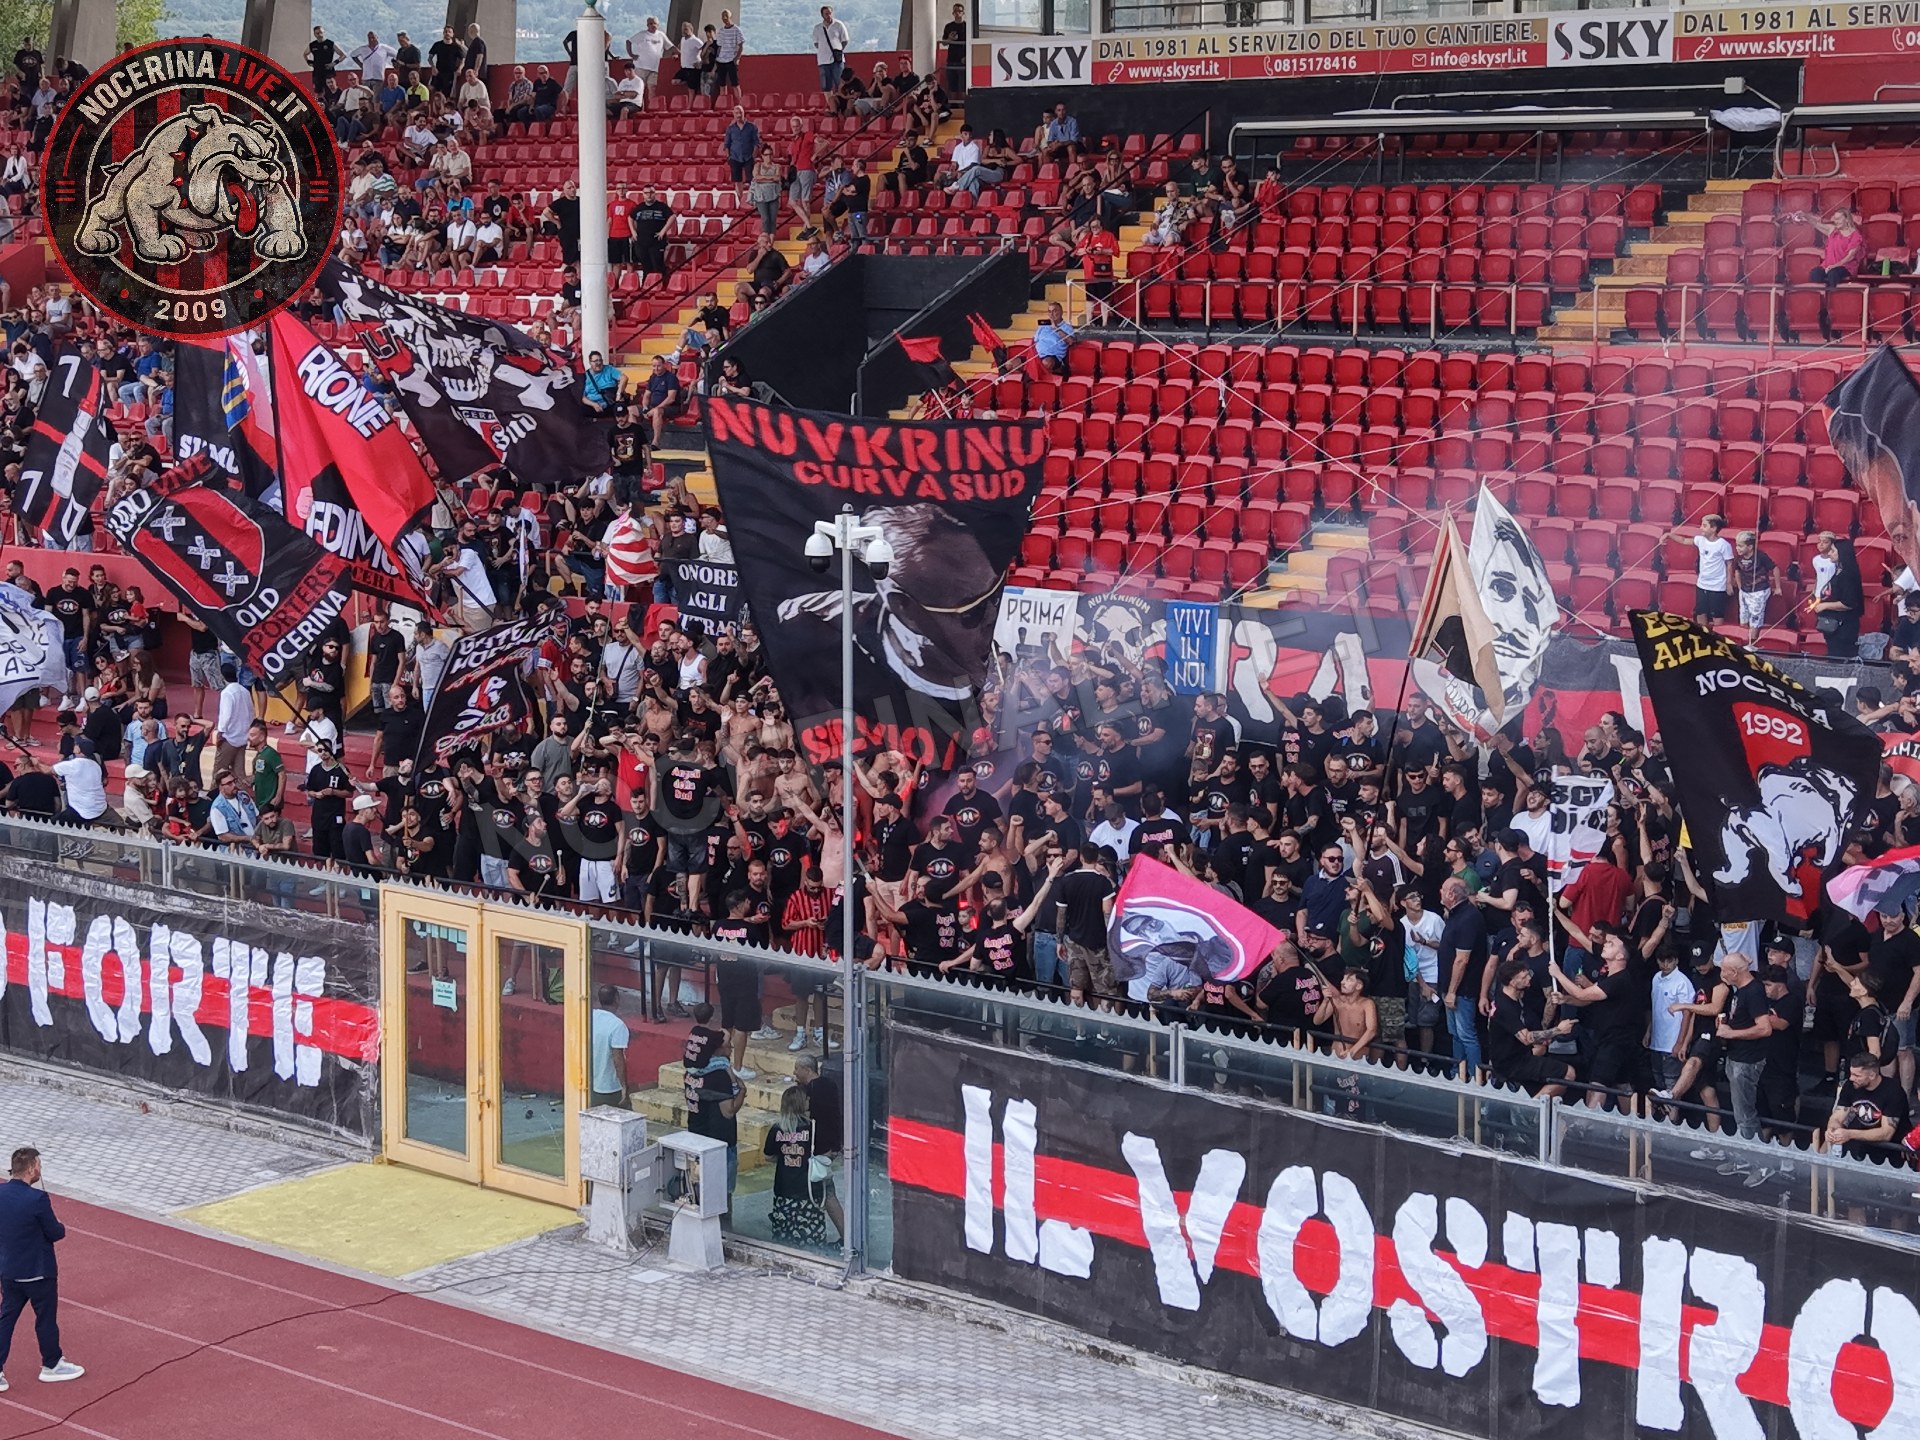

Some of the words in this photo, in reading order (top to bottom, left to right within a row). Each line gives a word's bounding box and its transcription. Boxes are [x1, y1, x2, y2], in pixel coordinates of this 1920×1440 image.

[1683, 13, 1729, 33] DAL
[1740, 10, 1795, 31] 1981
[1807, 8, 1837, 28] AL
[1099, 41, 1136, 59] DAL
[1144, 39, 1188, 57] 1981
[1197, 37, 1220, 55] AL
[1228, 32, 1321, 53] SERVIZIO
[1329, 30, 1367, 49] DEL
[1374, 26, 1417, 47] TUO
[1425, 22, 1539, 45] CANTIERE.
[1719, 34, 1836, 58] www.skysrl.it
[1128, 61, 1220, 80] www.skysrl.it
[1273, 56, 1357, 72] 0815178416
[1430, 48, 1528, 69] info@skysrl.it
[296, 343, 392, 440] RIONE
[708, 396, 1047, 474] NUVKRINU
[793, 460, 947, 501] CURVA
[949, 470, 1026, 501] SUD
[678, 563, 739, 587] ONORE
[236, 588, 280, 627] OLD
[687, 591, 727, 612] AGLI
[1006, 598, 1065, 627] PRIMA
[1173, 608, 1211, 635] VIVI
[1181, 636, 1200, 659] IN
[1653, 633, 1738, 671] ALLA
[1175, 661, 1206, 688] NOI
[1741, 711, 1803, 746] 1992
[28, 896, 326, 1087] FORTE
[775, 1130, 810, 1144] Angeli
[962, 1084, 1095, 1279] IL
[1121, 1131, 1920, 1440] VOSTRO
